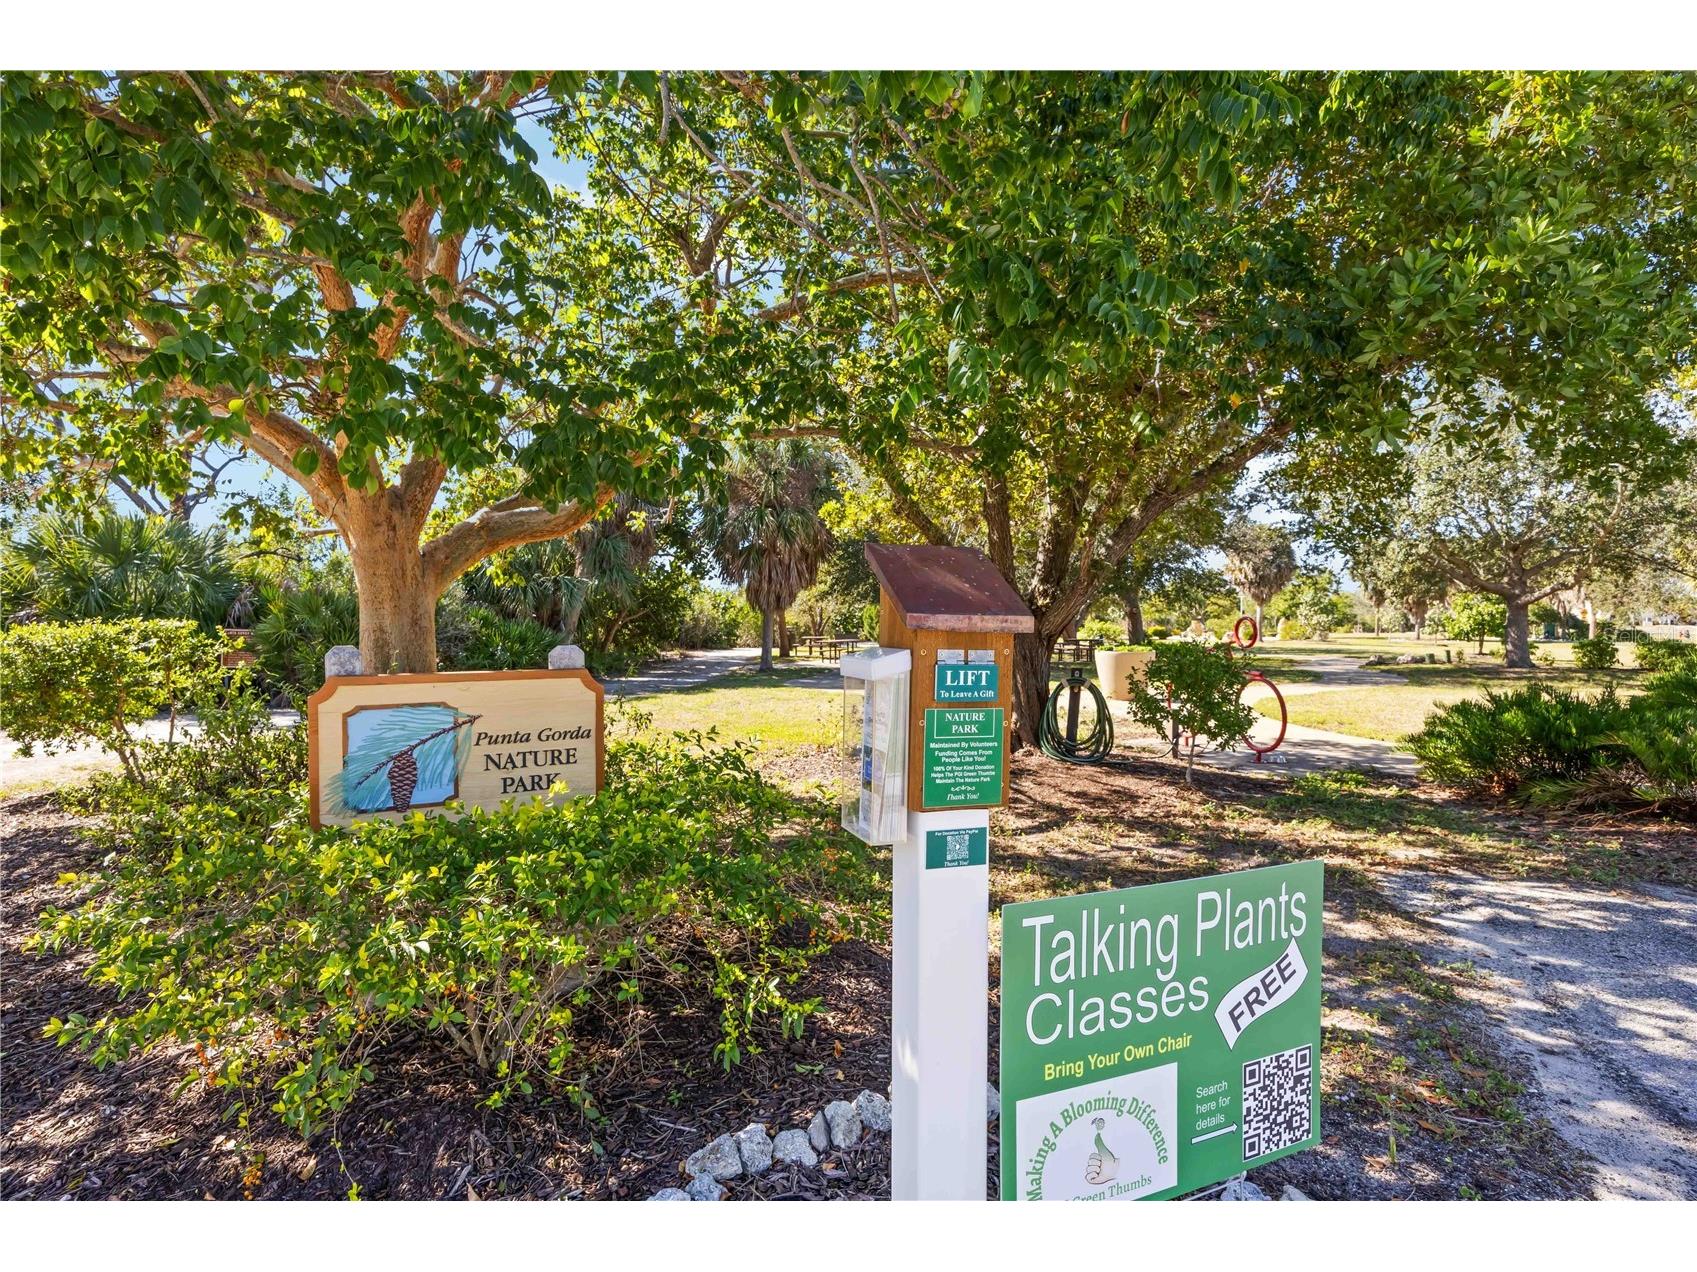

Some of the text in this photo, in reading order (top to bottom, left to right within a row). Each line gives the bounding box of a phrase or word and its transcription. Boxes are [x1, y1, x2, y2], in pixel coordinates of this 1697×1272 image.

[945, 670, 990, 686] LIFT
[940, 689, 994, 698] To Leave A Gift
[945, 712, 986, 722] NATURE
[474, 726, 592, 747] Punta Gorda
[952, 724, 979, 734] PARK
[961, 741, 969, 749] By
[484, 748, 578, 771] NATURE
[501, 772, 561, 794] PARK
[946, 792, 980, 801] Thank You!
[1021, 881, 1308, 987] Talking Plants
[1227, 952, 1297, 1033] FREE
[1025, 974, 1210, 1046] Classes
[1044, 1032, 1193, 1081] Bring Your Own Chair
[1196, 1080, 1228, 1099] Search
[1196, 1095, 1231, 1115] here for
[1195, 1113, 1225, 1131] details
[1026, 1090, 1169, 1201] Making A Blooming Difference
[1107, 1174, 1152, 1198] Thumbs
